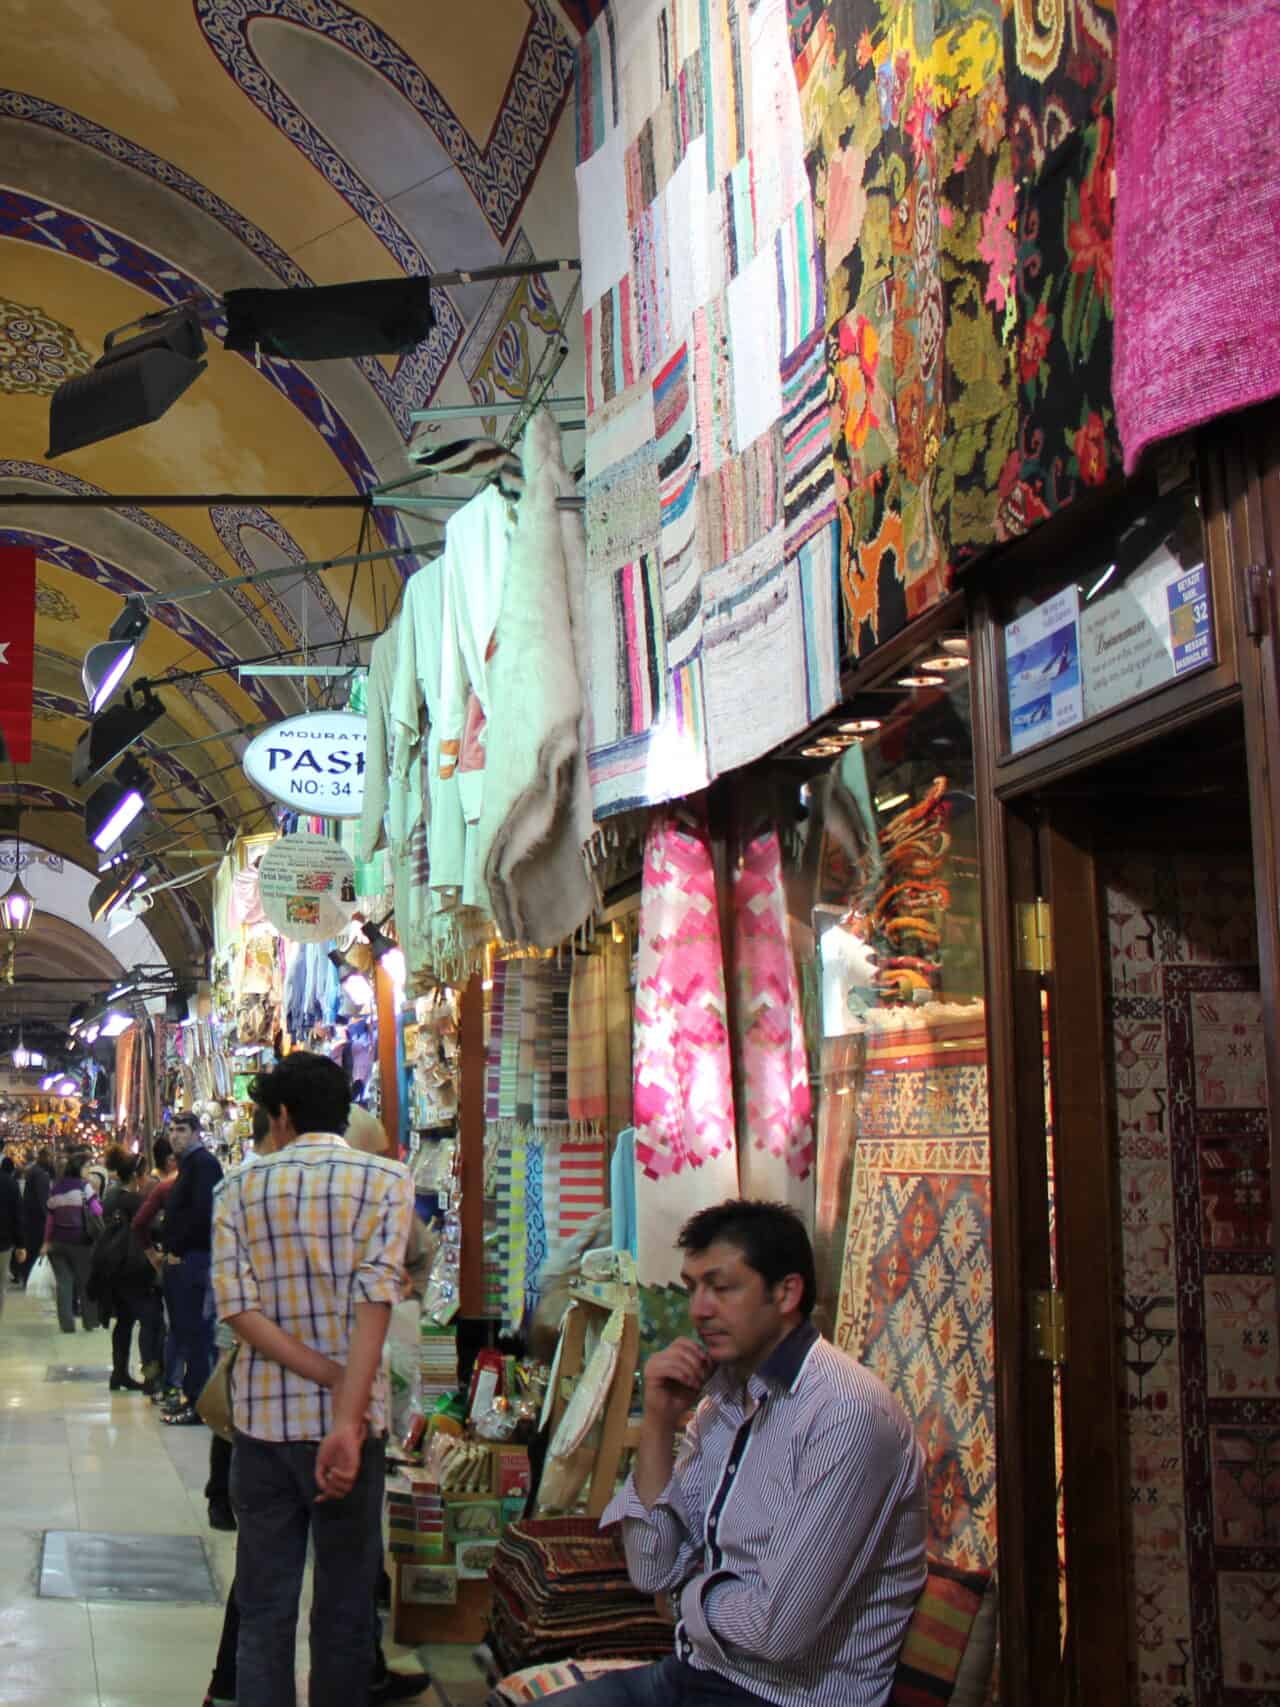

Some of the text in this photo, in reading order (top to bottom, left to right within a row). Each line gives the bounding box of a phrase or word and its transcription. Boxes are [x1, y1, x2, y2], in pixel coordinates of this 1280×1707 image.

[1193, 601, 1208, 624] 32
[290, 779, 324, 795] NO:
[331, 781, 351, 796] 34
